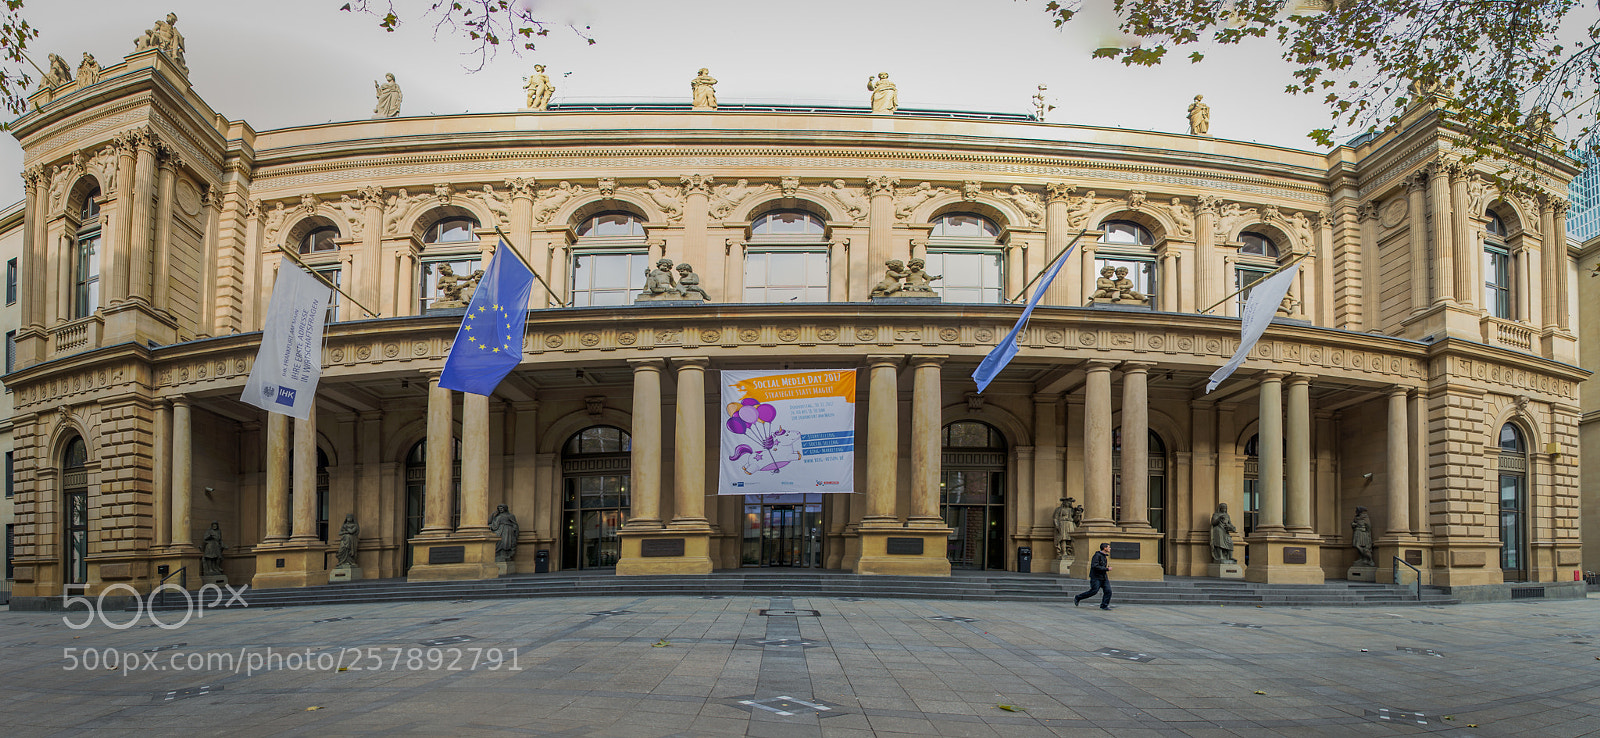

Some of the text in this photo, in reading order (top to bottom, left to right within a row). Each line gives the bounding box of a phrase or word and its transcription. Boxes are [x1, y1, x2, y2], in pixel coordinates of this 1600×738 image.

[291, 308, 309, 380] IHRE ERSTE ADRESSE
[301, 374, 309, 383] IN
[753, 372, 841, 389] SOCIAL MEDIA DAY 2017
[280, 388, 295, 399] IHK
